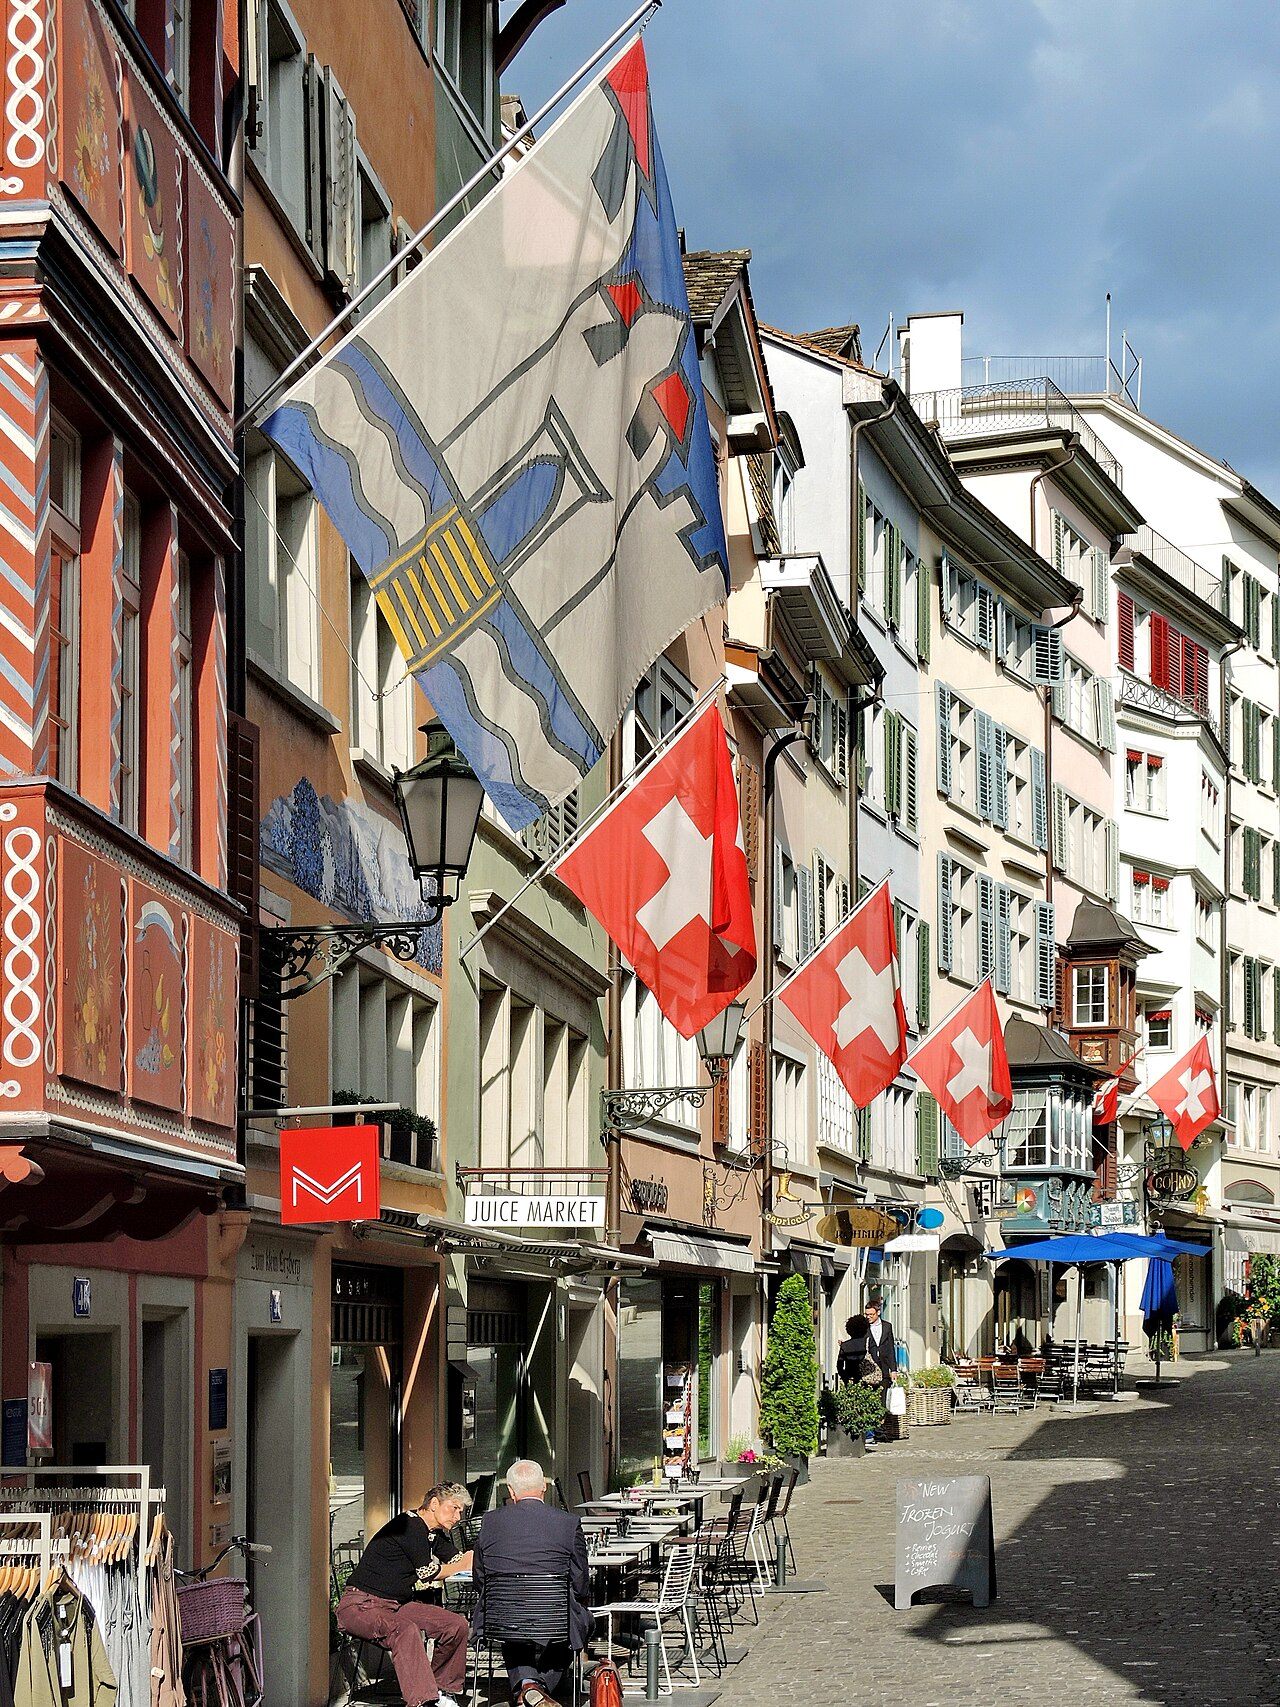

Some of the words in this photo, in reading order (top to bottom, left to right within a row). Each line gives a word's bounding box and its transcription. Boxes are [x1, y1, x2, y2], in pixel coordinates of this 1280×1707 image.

[471, 1200, 519, 1222] JUICE
[526, 1200, 598, 1223] MARKET
[765, 1212, 811, 1227] capriccio
[900, 1503, 954, 1524] FROZEN
[924, 1520, 976, 1541] JOGURT
